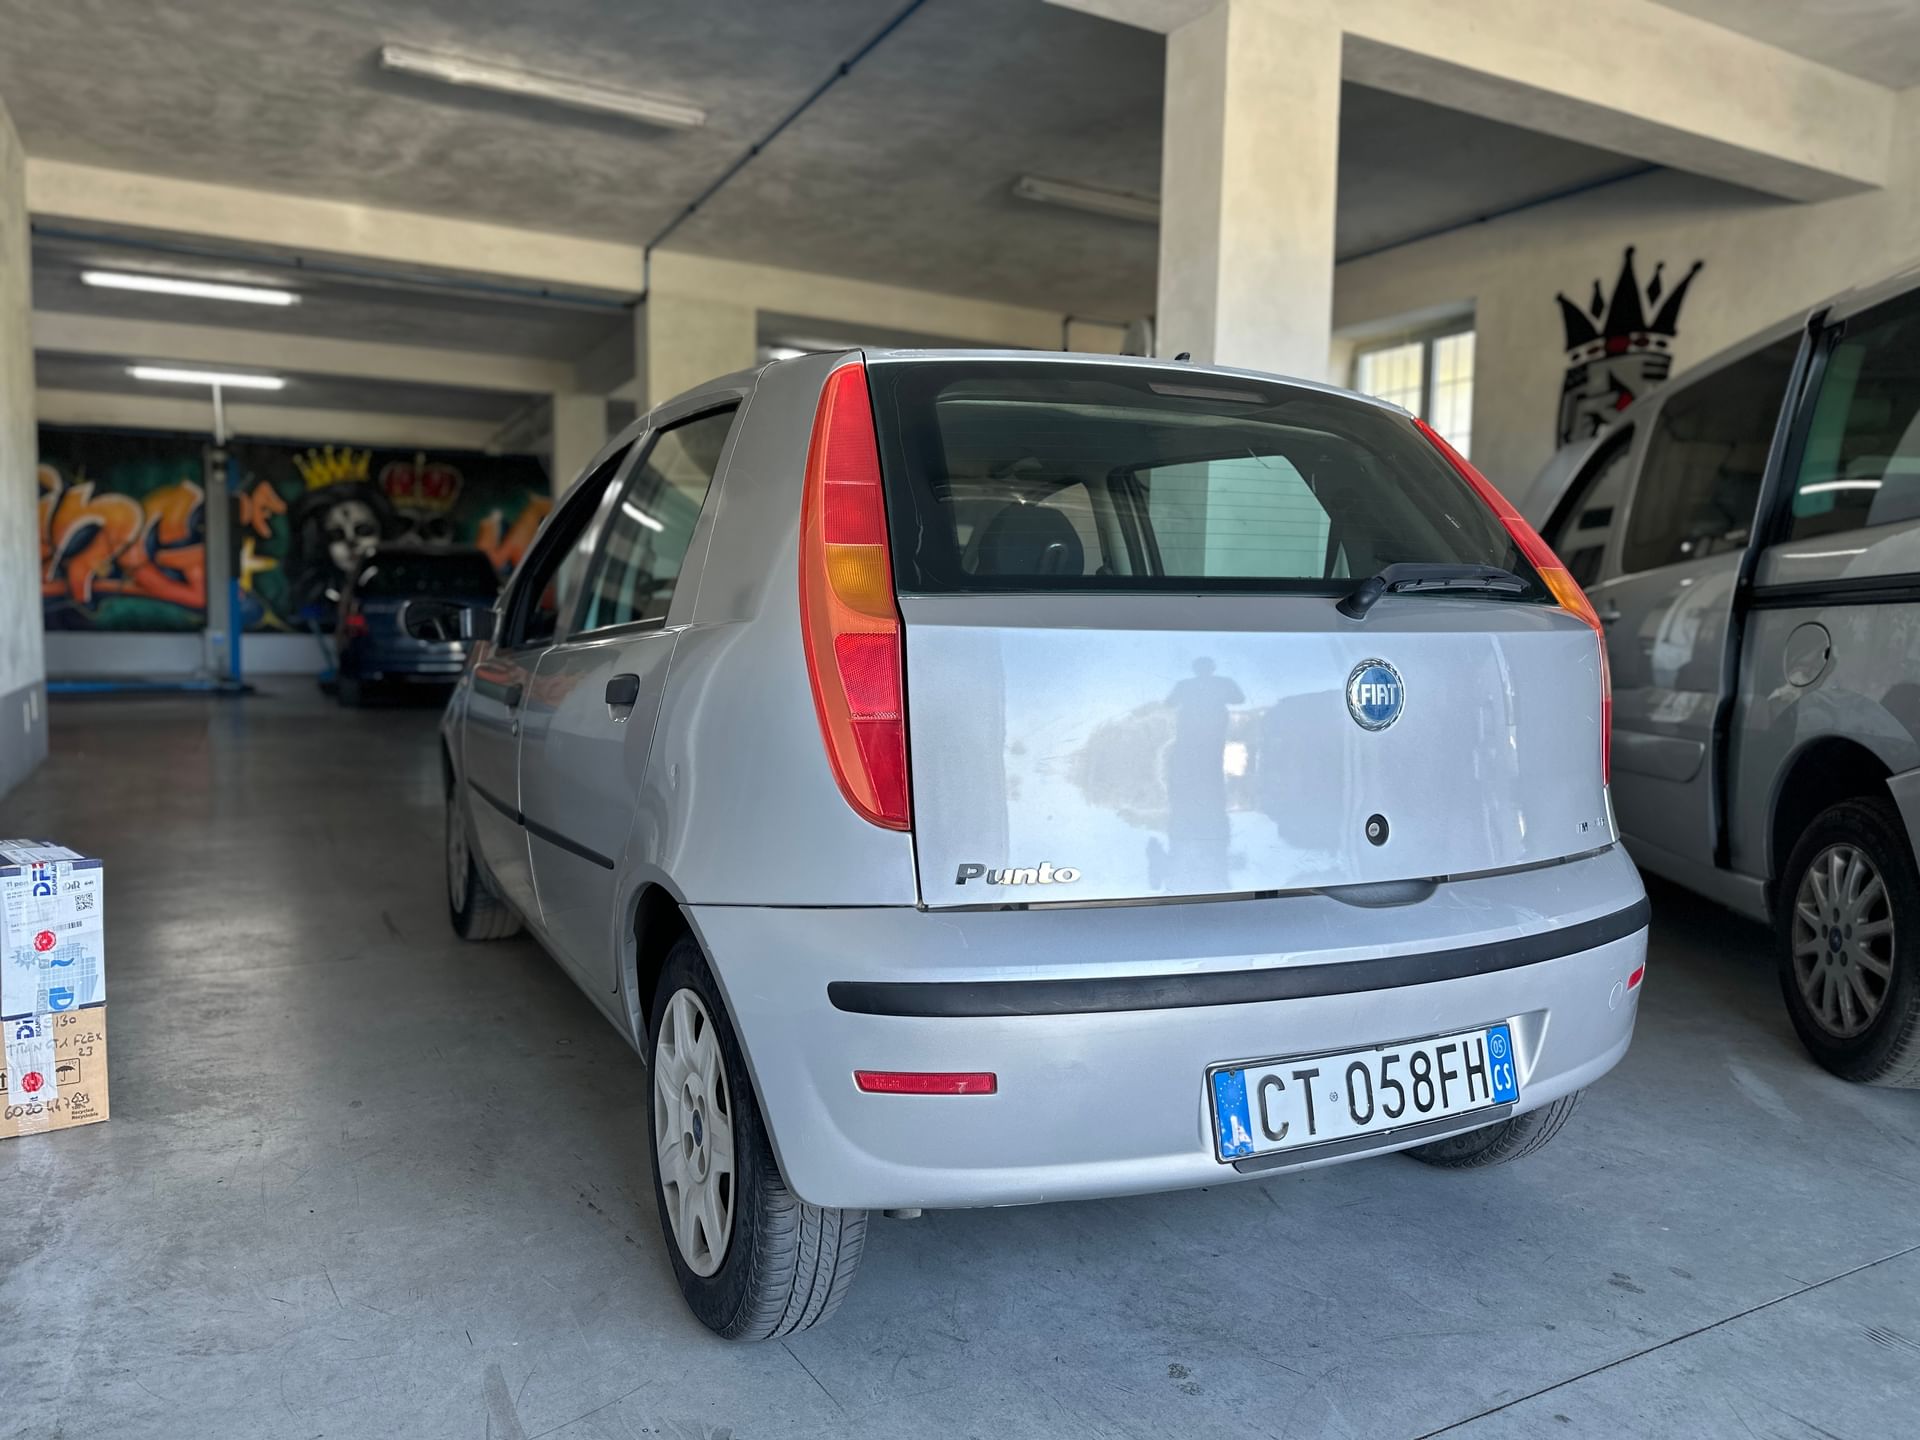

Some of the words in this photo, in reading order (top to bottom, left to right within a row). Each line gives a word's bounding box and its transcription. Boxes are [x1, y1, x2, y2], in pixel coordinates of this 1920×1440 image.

[1361, 683, 1397, 705] FIAT
[955, 861, 1081, 885] Punto
[74, 1032, 102, 1046] FLEX
[1493, 1039, 1503, 1054] 05
[78, 1046, 93, 1056] 23
[1494, 1062, 1511, 1091] CS
[1257, 1067, 1320, 1142] CT
[1345, 1037, 1490, 1126] 058FH
